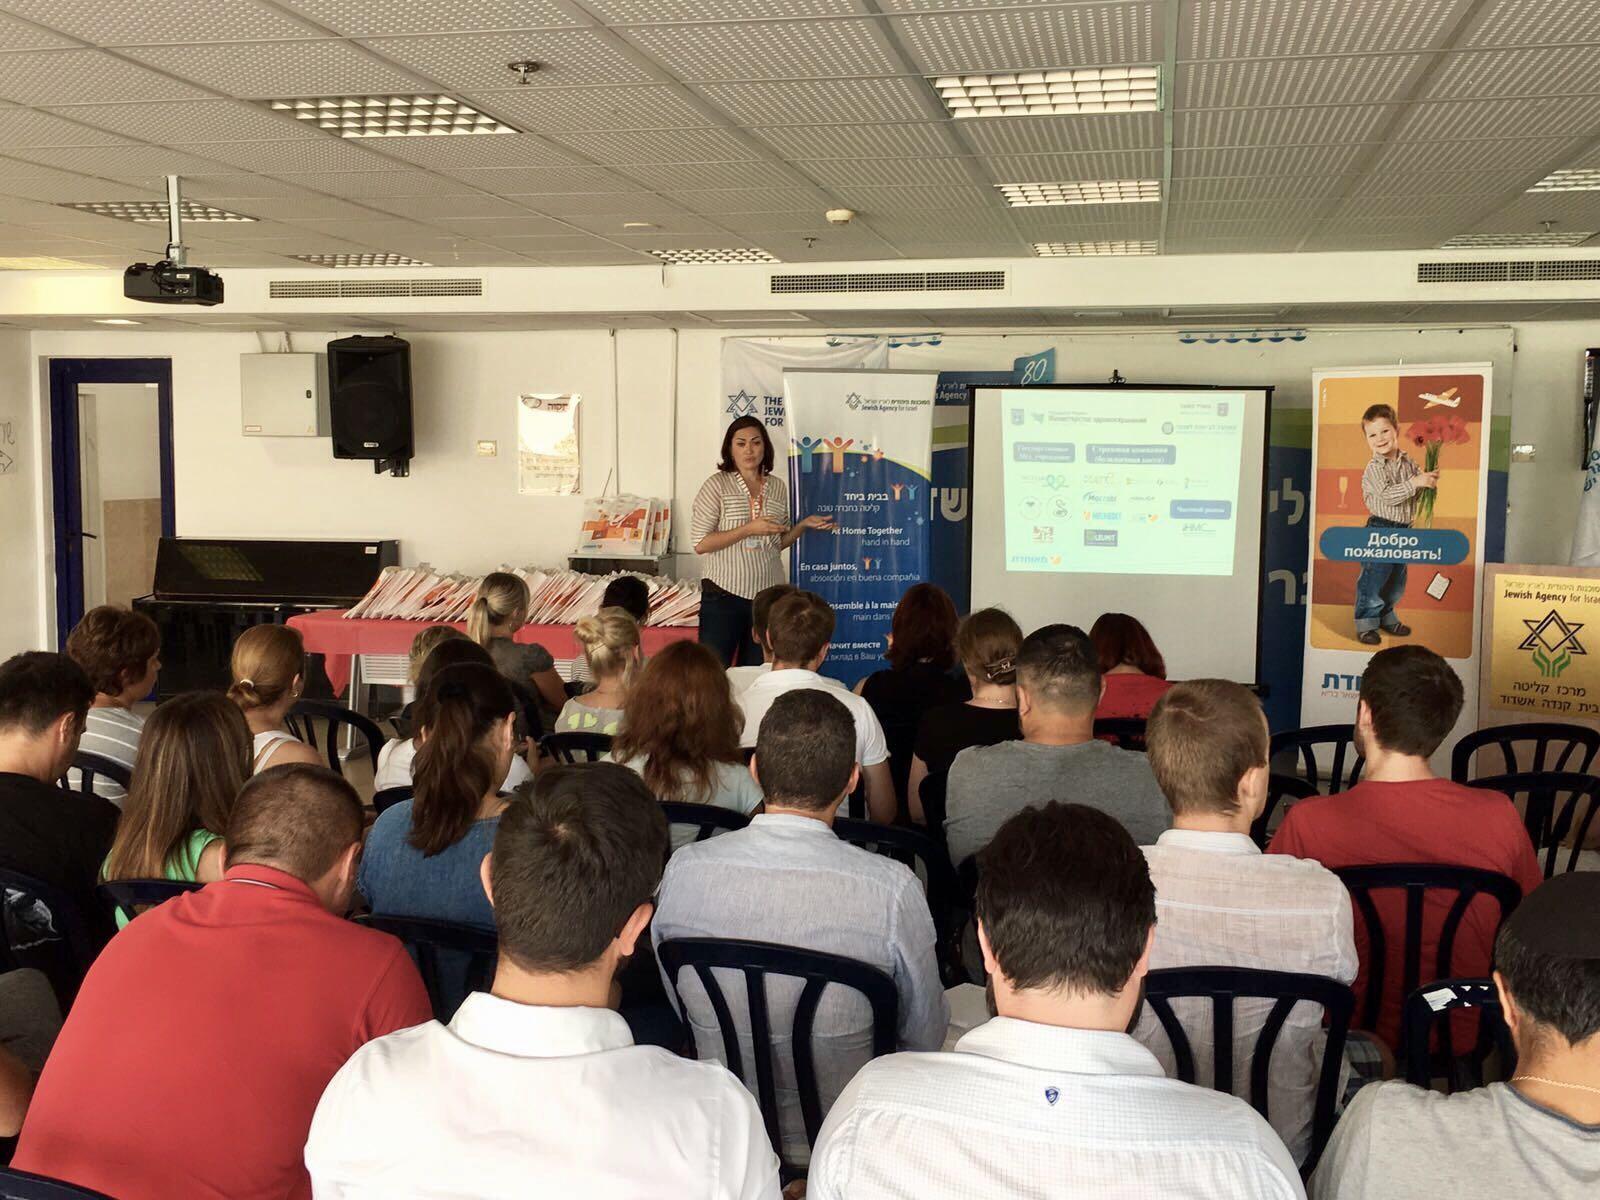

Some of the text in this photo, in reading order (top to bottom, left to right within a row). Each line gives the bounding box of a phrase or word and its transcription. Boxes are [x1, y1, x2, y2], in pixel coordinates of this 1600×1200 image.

[1021, 358, 1047, 386] 80
[763, 396, 783, 405] THE
[941, 391, 967, 402] Agency
[880, 404, 897, 412] Agency
[765, 417, 784, 427] FOR
[844, 493, 889, 501] בבית ביחד
[842, 527, 867, 535] Home
[867, 526, 903, 537] Together
[861, 538, 910, 546] hand in hand
[1367, 532, 1419, 547] Добро
[1344, 547, 1442, 560] пожаловать!
[800, 562, 811, 571] En
[829, 563, 858, 572] juntos,
[810, 573, 846, 582] absorción
[858, 573, 882, 582] buena
[1577, 584, 1600, 593] סוכנות
[1503, 589, 1532, 600] Jewish
[1535, 591, 1567, 603] Agency
[1570, 593, 1581, 603] for
[872, 600, 879, 609] la
[853, 612, 871, 622] main
[872, 612, 890, 621] dans
[1512, 680, 1587, 697] מרכז קליטה
[1500, 693, 1600, 714] בית קנדה אשדוד
